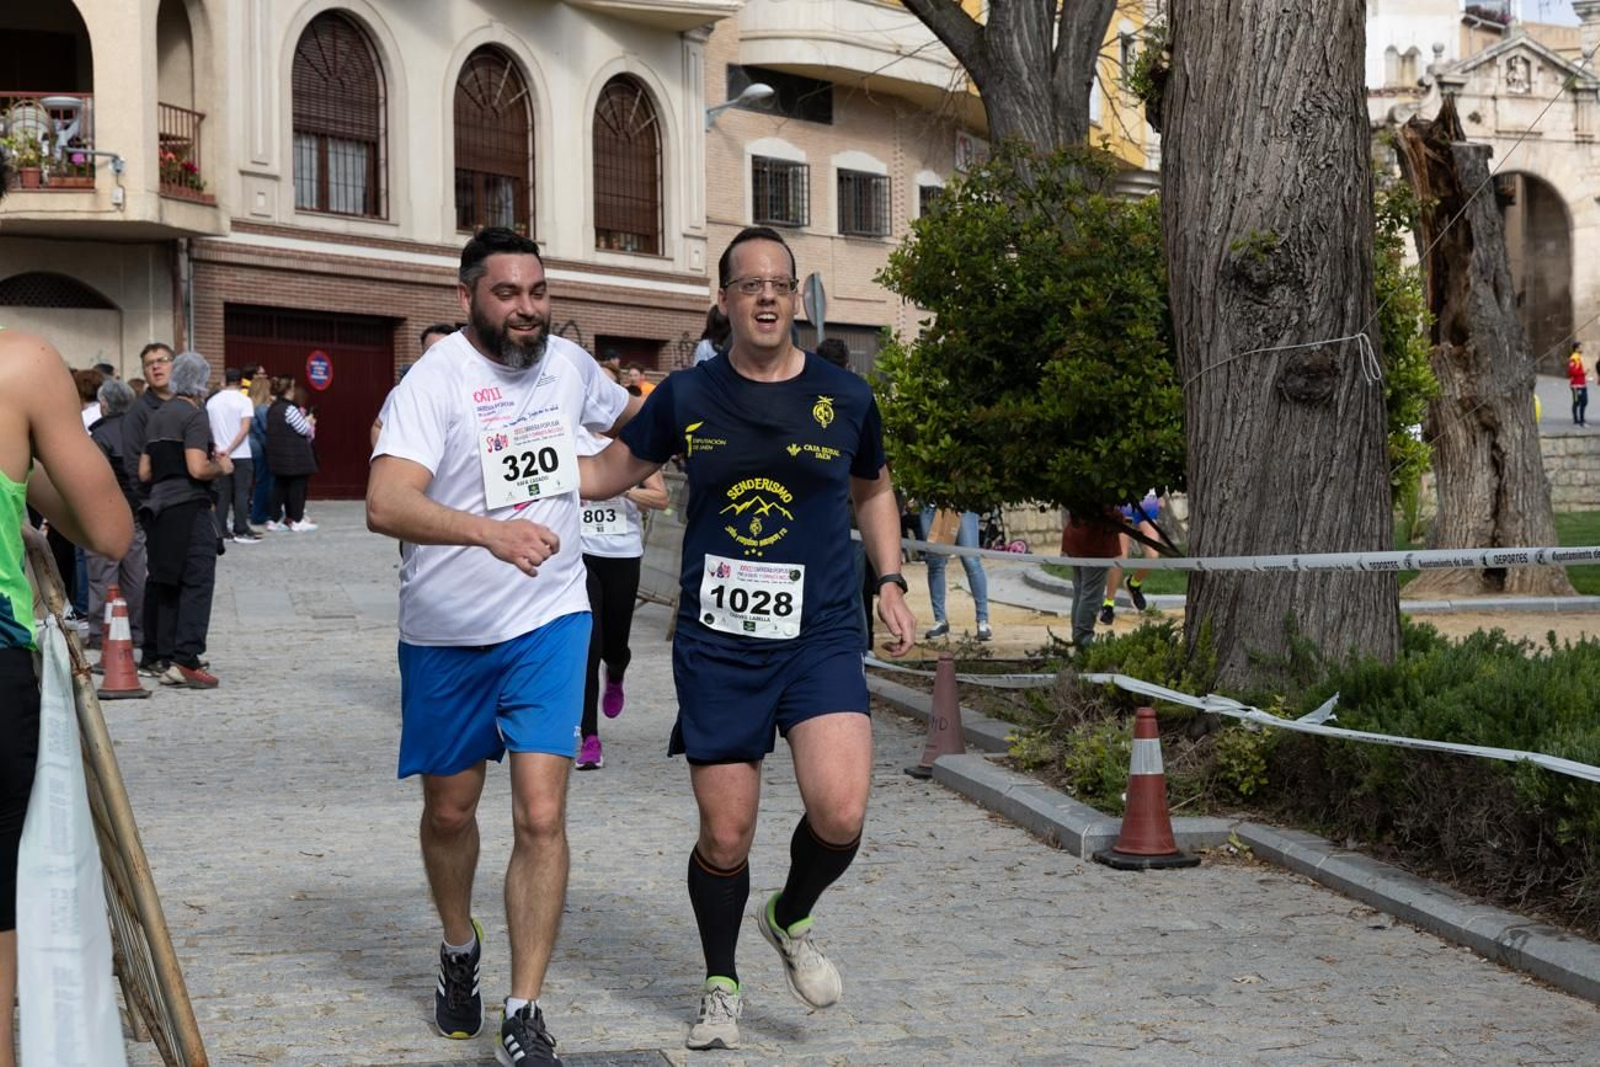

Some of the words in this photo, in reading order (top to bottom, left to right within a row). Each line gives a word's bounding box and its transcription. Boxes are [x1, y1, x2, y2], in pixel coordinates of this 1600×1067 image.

[502, 446, 559, 482] 320
[727, 478, 794, 503] SENDERISMO
[583, 508, 617, 523] 803
[1493, 552, 1528, 565] DEPORTES
[710, 585, 793, 617] 1028
